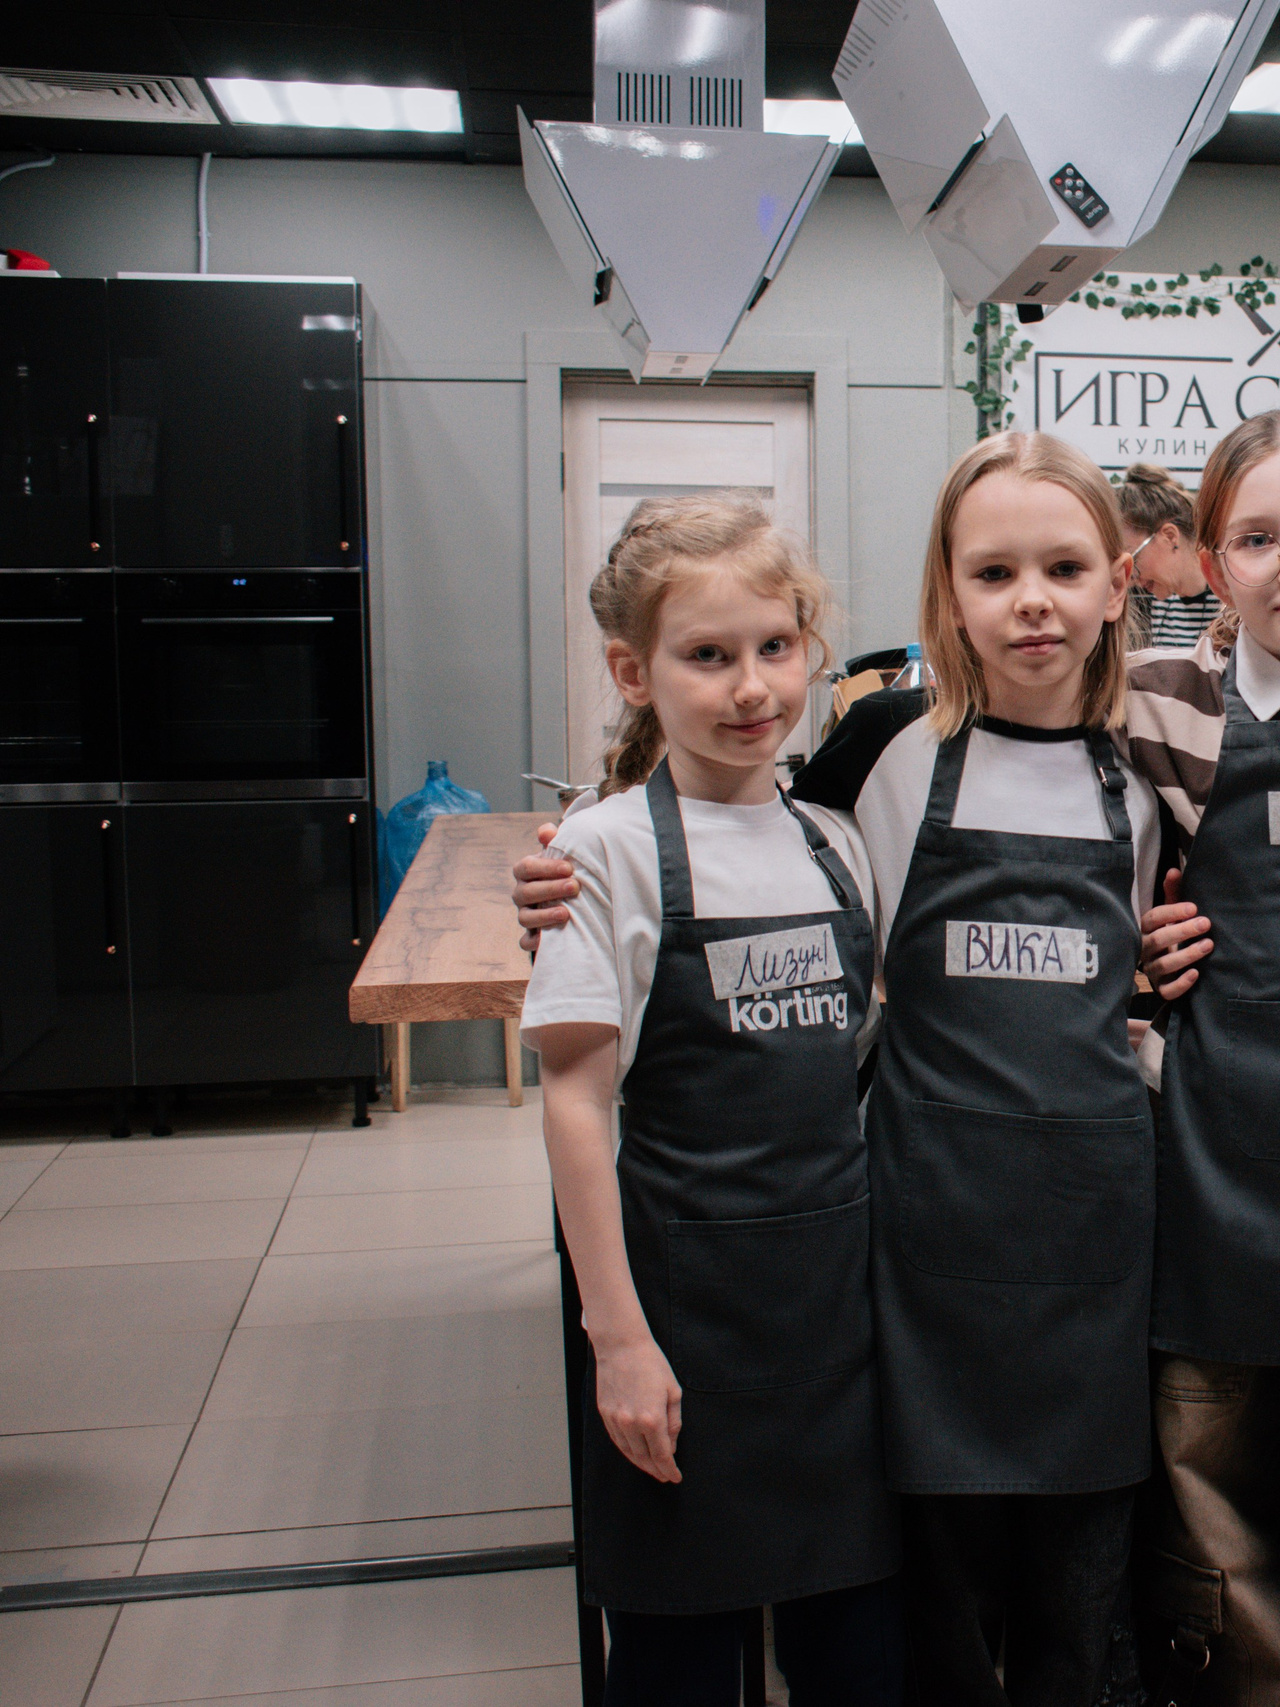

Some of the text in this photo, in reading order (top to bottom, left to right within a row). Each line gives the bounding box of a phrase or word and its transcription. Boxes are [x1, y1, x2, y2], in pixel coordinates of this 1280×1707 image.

[1052, 369, 1218, 429] ИГРА
[1118, 438, 1207, 456] КУЛИН
[966, 923, 1063, 974] ВИКА
[729, 987, 848, 1033] körting
